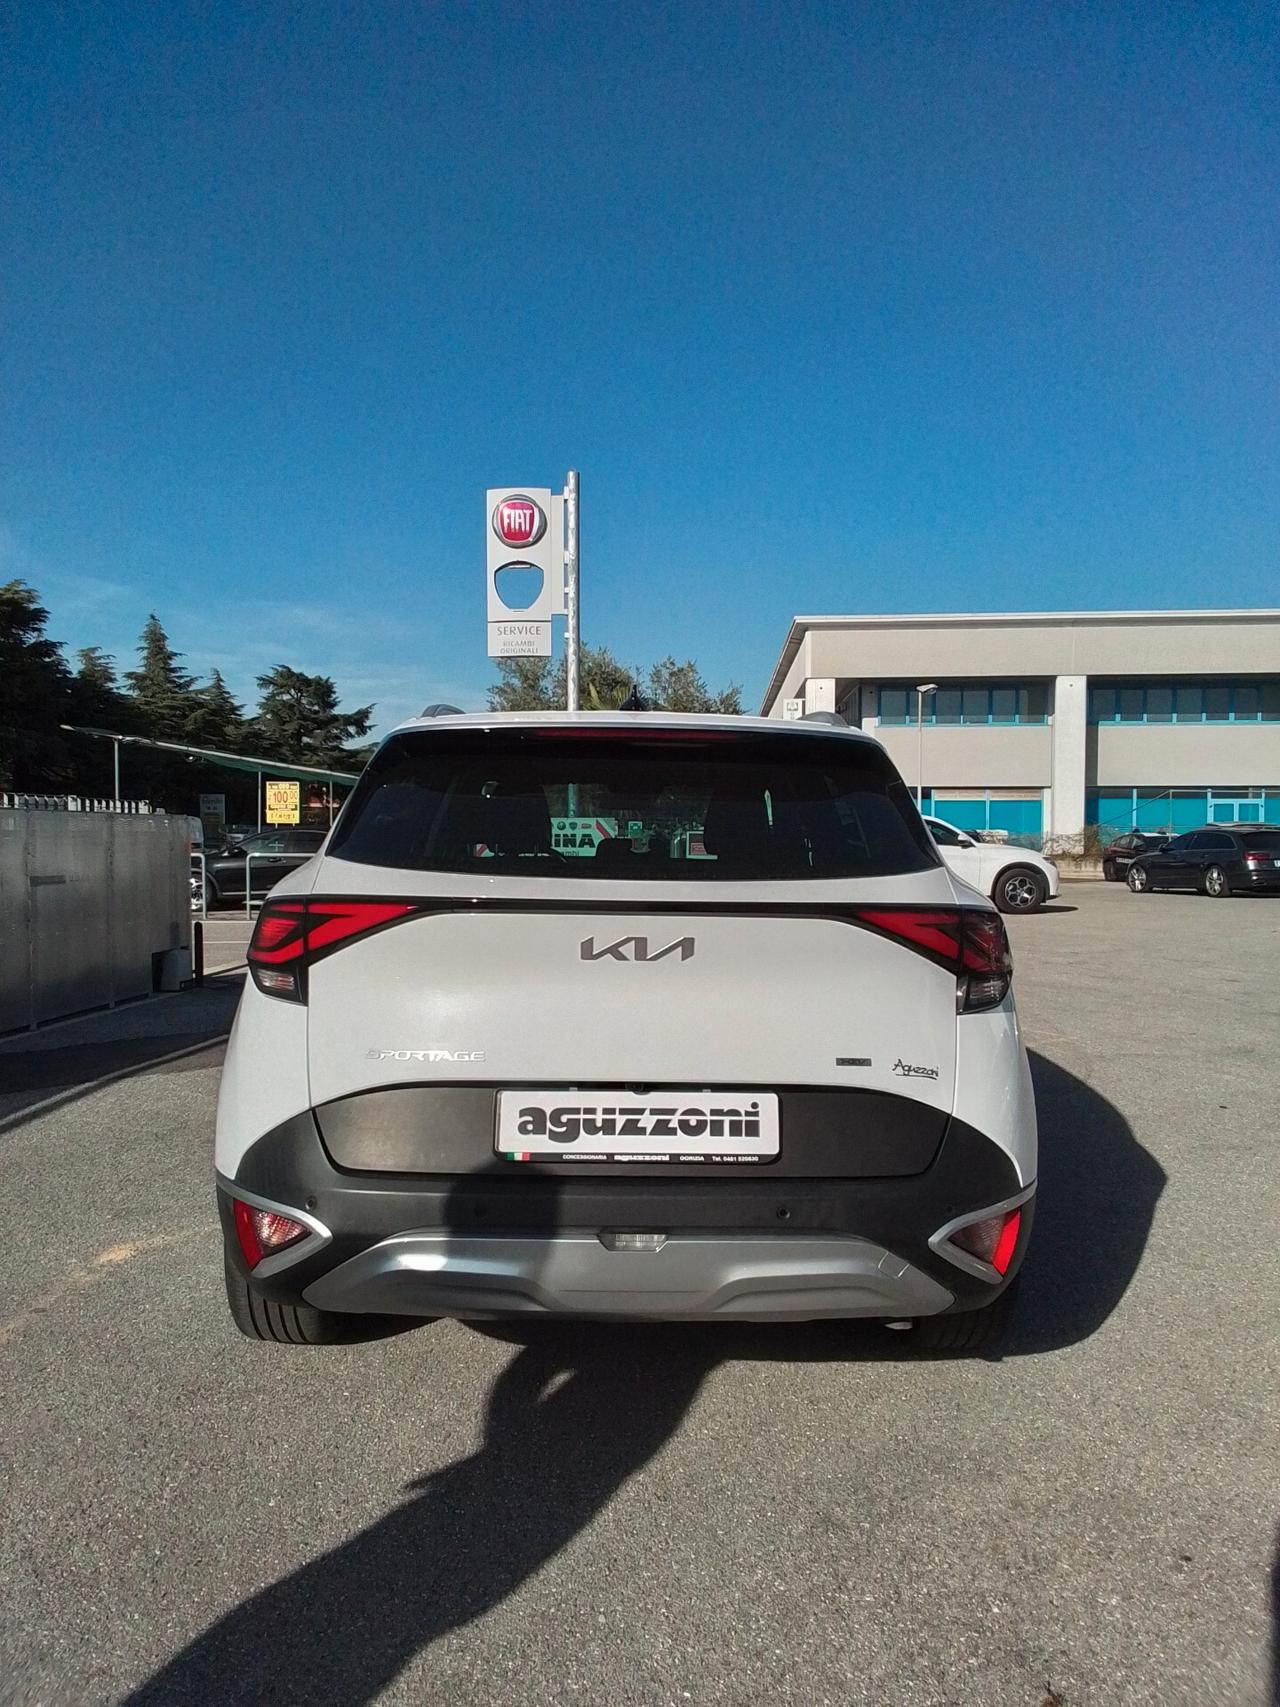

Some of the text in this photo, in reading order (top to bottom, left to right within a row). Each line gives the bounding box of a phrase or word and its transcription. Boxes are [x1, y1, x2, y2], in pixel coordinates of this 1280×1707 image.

[502, 507, 533, 533] FIAT
[497, 625, 542, 636] SERVICE
[273, 790, 288, 803] 100
[580, 936, 695, 961] KIA
[366, 1049, 485, 1062] SPORTAGE
[517, 1101, 760, 1143] aguzzoni
[613, 1154, 670, 1162] aguzzoni
